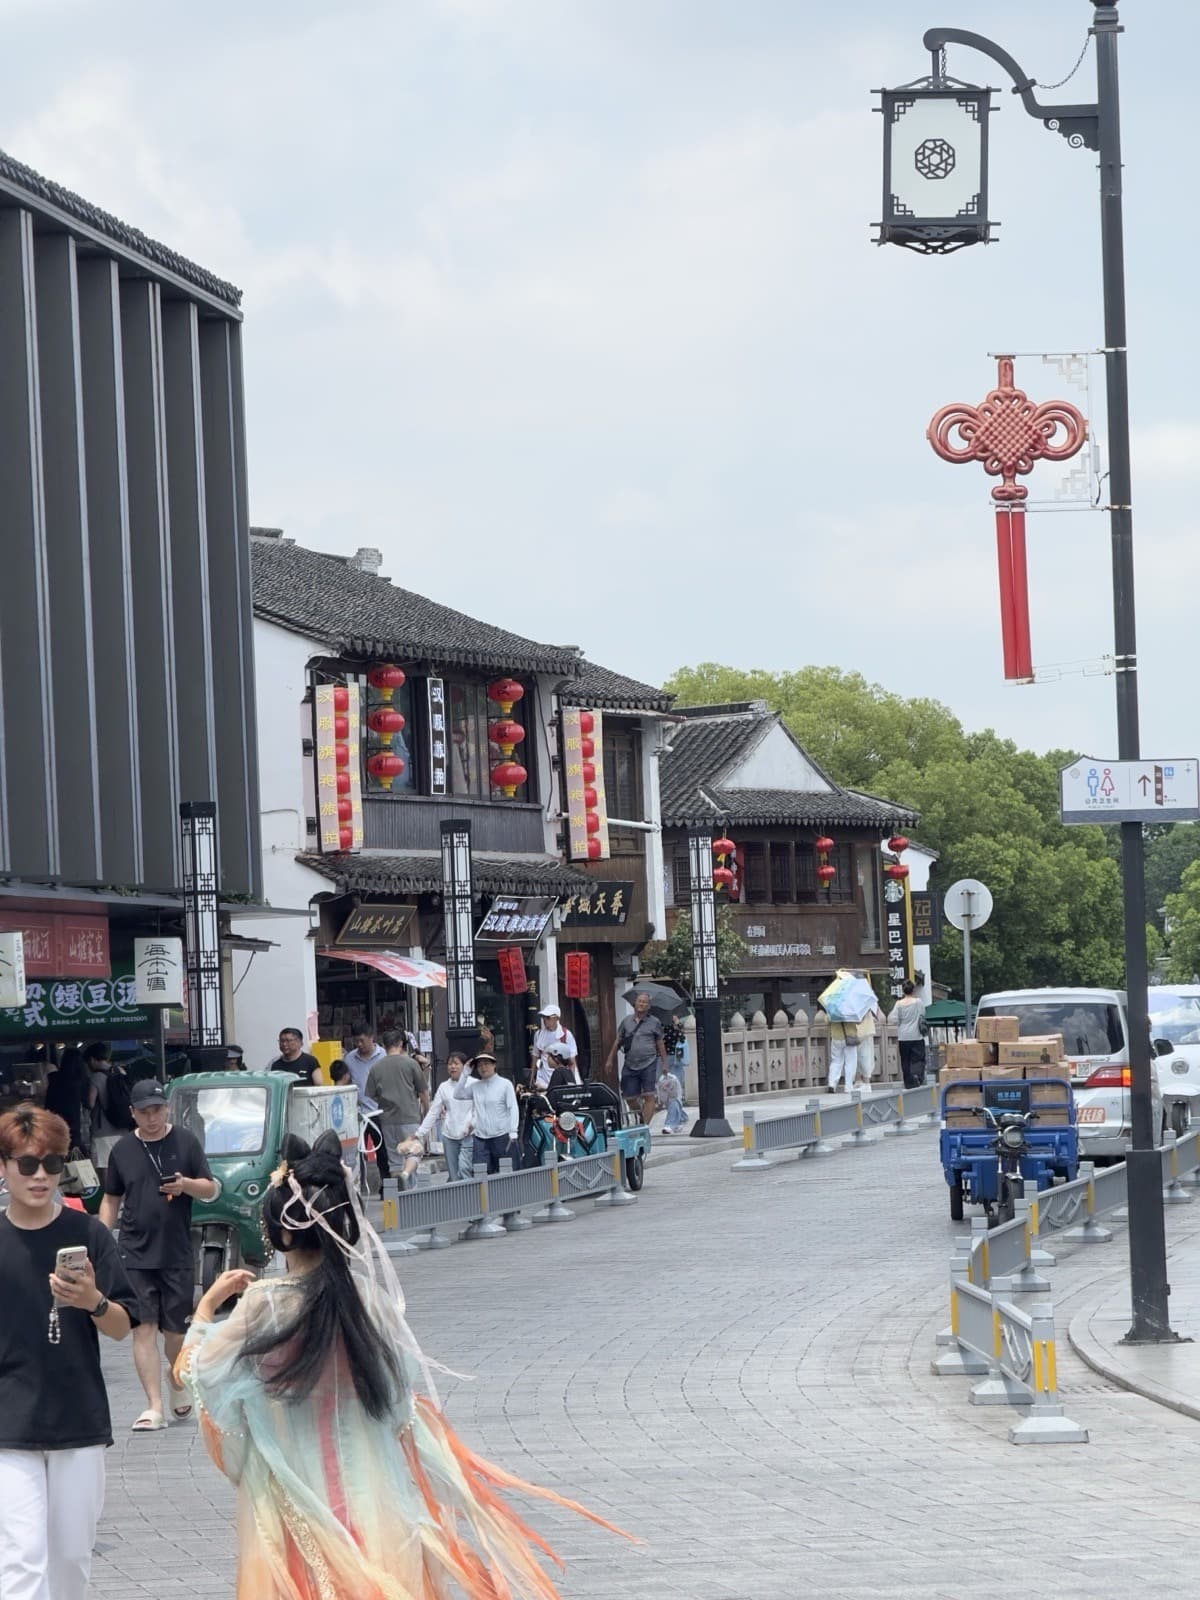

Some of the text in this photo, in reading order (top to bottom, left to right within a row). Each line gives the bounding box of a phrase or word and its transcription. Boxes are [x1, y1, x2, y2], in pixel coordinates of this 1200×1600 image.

[888, 912, 905, 997] 星巴克咖啡
